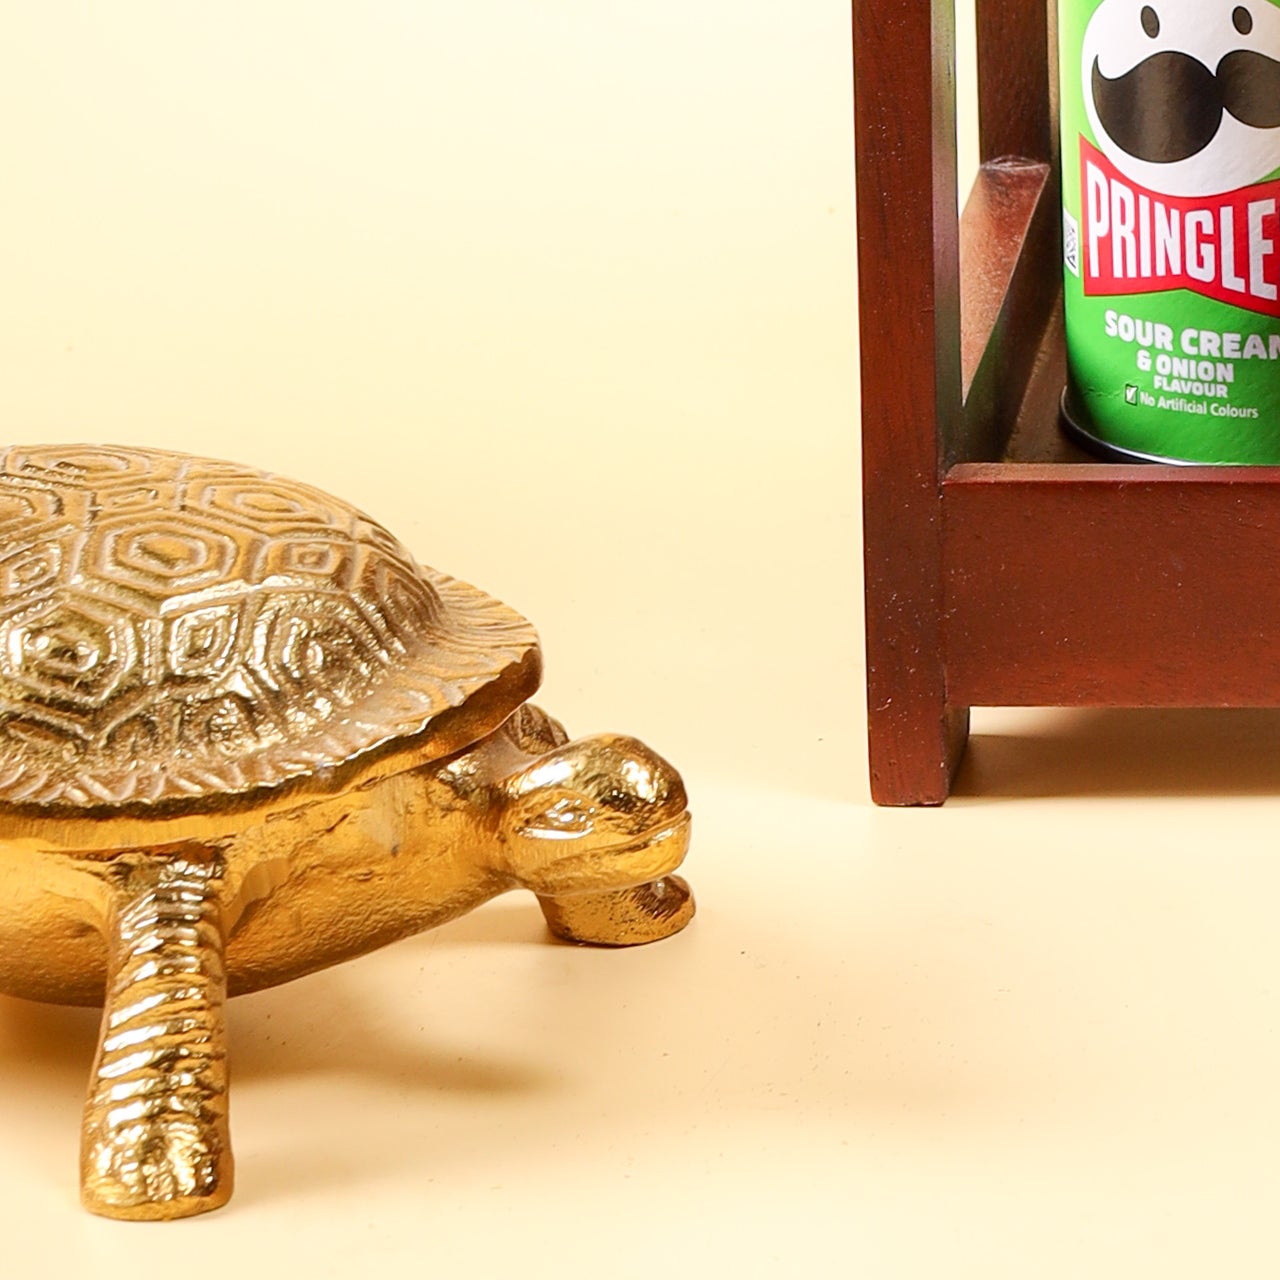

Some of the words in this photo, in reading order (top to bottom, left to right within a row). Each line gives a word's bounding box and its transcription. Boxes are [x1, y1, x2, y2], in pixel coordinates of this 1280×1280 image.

[1104, 309, 1174, 352] SOUR
[1136, 349, 1152, 372] &
[1155, 353, 1235, 383] ONION
[1153, 375, 1229, 398] FLAVOUR
[1139, 391, 1156, 407] No
[1157, 394, 1208, 416] Artificial
[1210, 403, 1260, 420] Colours
